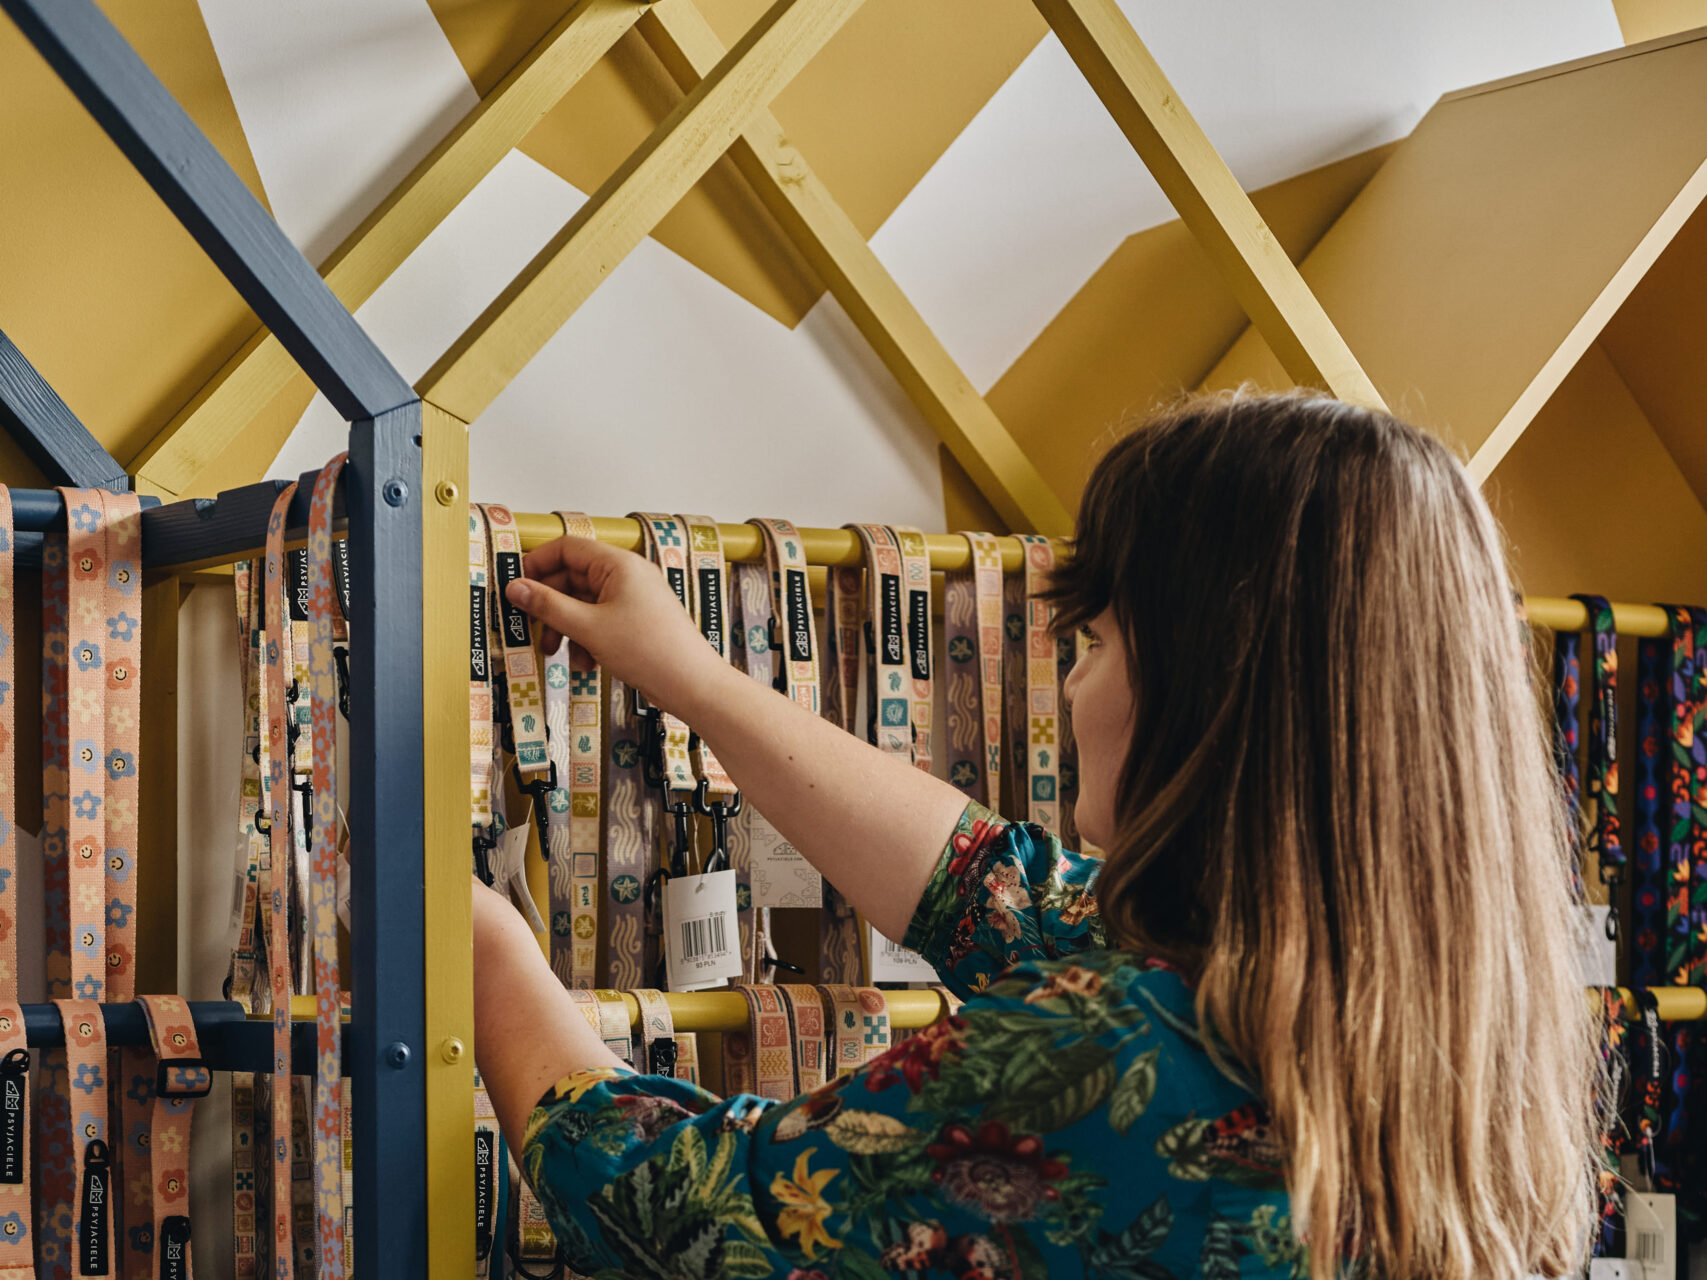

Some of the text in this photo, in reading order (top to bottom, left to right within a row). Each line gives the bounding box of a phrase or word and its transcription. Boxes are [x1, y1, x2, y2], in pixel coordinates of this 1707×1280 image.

[708, 574, 717, 630] PSYJACIELE
[794, 576, 805, 630] PSYJACIELE
[889, 579, 899, 634] PSYJACIELE
[5, 1112, 15, 1177] PSYJACIELE
[477, 1167, 486, 1227] PSYJACIELE
[90, 1206, 99, 1269] PSYJACIELE
